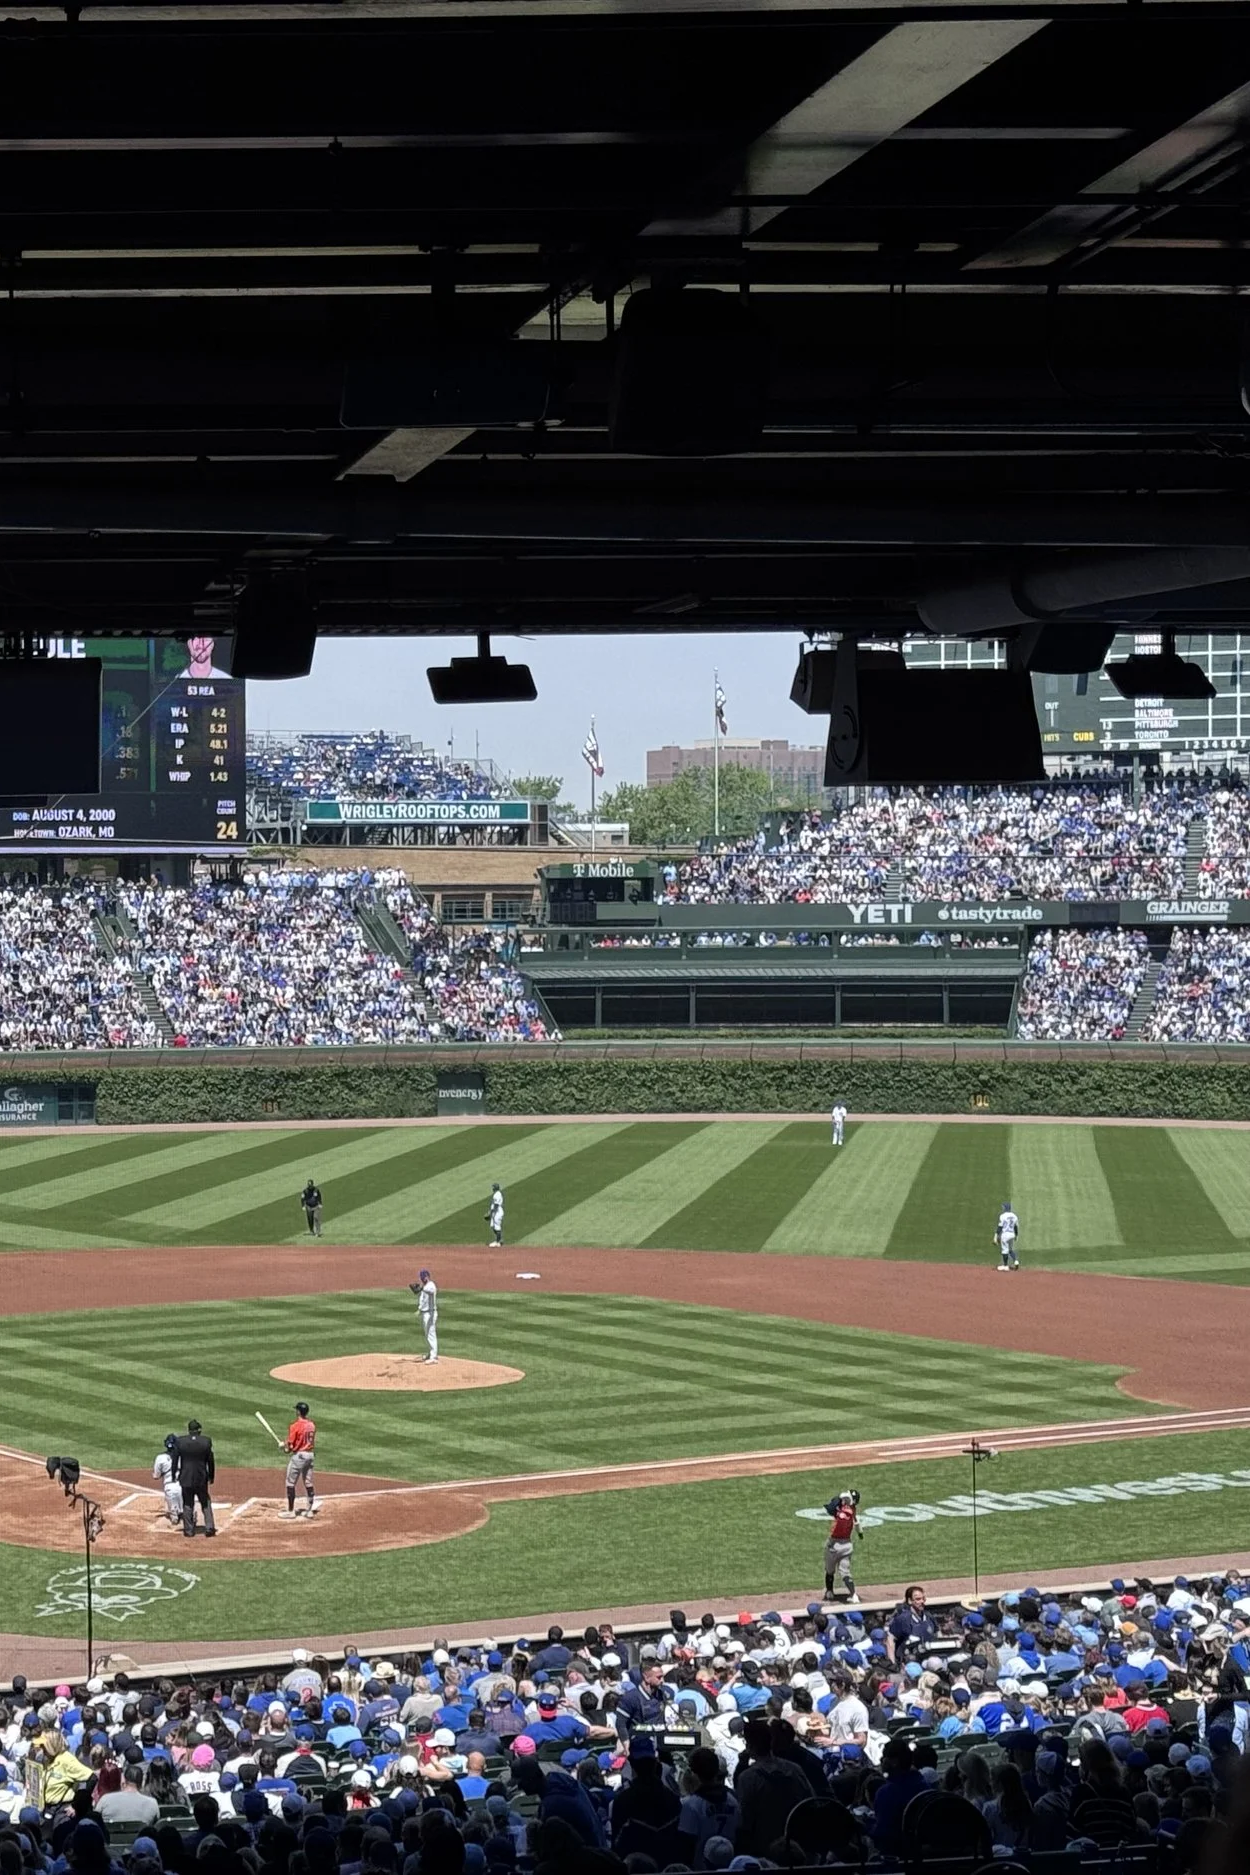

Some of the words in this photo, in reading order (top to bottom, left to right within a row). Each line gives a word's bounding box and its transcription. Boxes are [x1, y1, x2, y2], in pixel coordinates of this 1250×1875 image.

[187, 686, 197, 695] 53
[199, 686, 215, 695] REA
[1045, 702, 1059, 710] OUT
[1135, 699, 1164, 707] DETROIT
[171, 707, 188, 717] W-L
[211, 707, 226, 717] 4-2
[1135, 708, 1173, 717] BALTIMORE
[170, 723, 189, 734] ERA
[210, 723, 227, 734] 5.21
[1135, 720, 1178, 729] PITTSBURGH
[1073, 732, 1095, 741] CUBS
[1135, 730, 1169, 739] TORONTO
[175, 739, 185, 749] IP
[209, 739, 228, 750] 48.1
[1193, 741, 1200, 749] 2
[1203, 741, 1209, 749] 3
[1212, 740, 1218, 748] 4
[1230, 740, 1237, 748] 6
[1240, 740, 1247, 748] 7
[176, 755, 184, 765] K
[213, 755, 224, 765] 41
[169, 771, 191, 782] WHIP
[210, 771, 228, 782] 1.43
[32, 809, 75, 821] AUGUST
[76, 809, 87, 822] 4,
[89, 809, 115, 821] 2000
[339, 804, 500, 819] WRIGLEYROOFTOPS.COM
[58, 826, 96, 839] OZARK,
[98, 826, 114, 838] MO
[217, 821, 238, 840] 24
[588, 863, 634, 877] Mobile
[847, 903, 912, 923] YETI
[950, 906, 1044, 924] tastytrade
[1146, 901, 1229, 914] GRAINGER
[189, 1782, 213, 1792] ROSS
